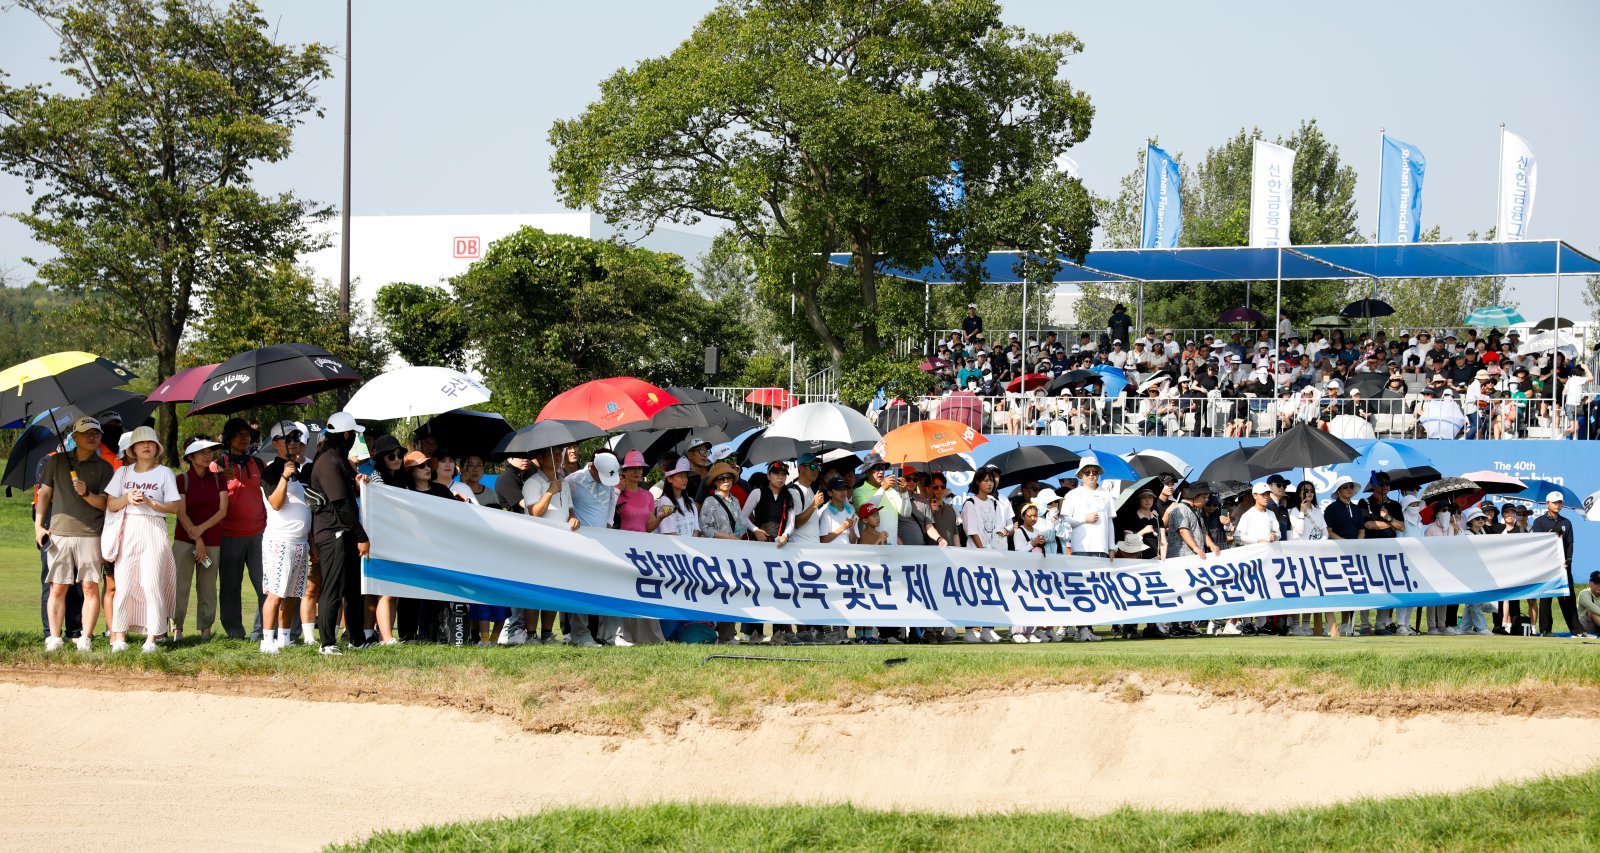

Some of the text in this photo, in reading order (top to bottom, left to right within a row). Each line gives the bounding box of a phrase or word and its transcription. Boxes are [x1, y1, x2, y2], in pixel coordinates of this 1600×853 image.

[1397, 187, 1409, 233] Financial
[456, 240, 478, 255] DB
[212, 373, 251, 392] Callaway
[440, 377, 468, 398] 두산
[1494, 461, 1536, 471] The 40th
[624, 547, 1418, 613] 함께여서 더욱 빛난 제 40회 신한동해오픈, 성원에 감사드립니다.
